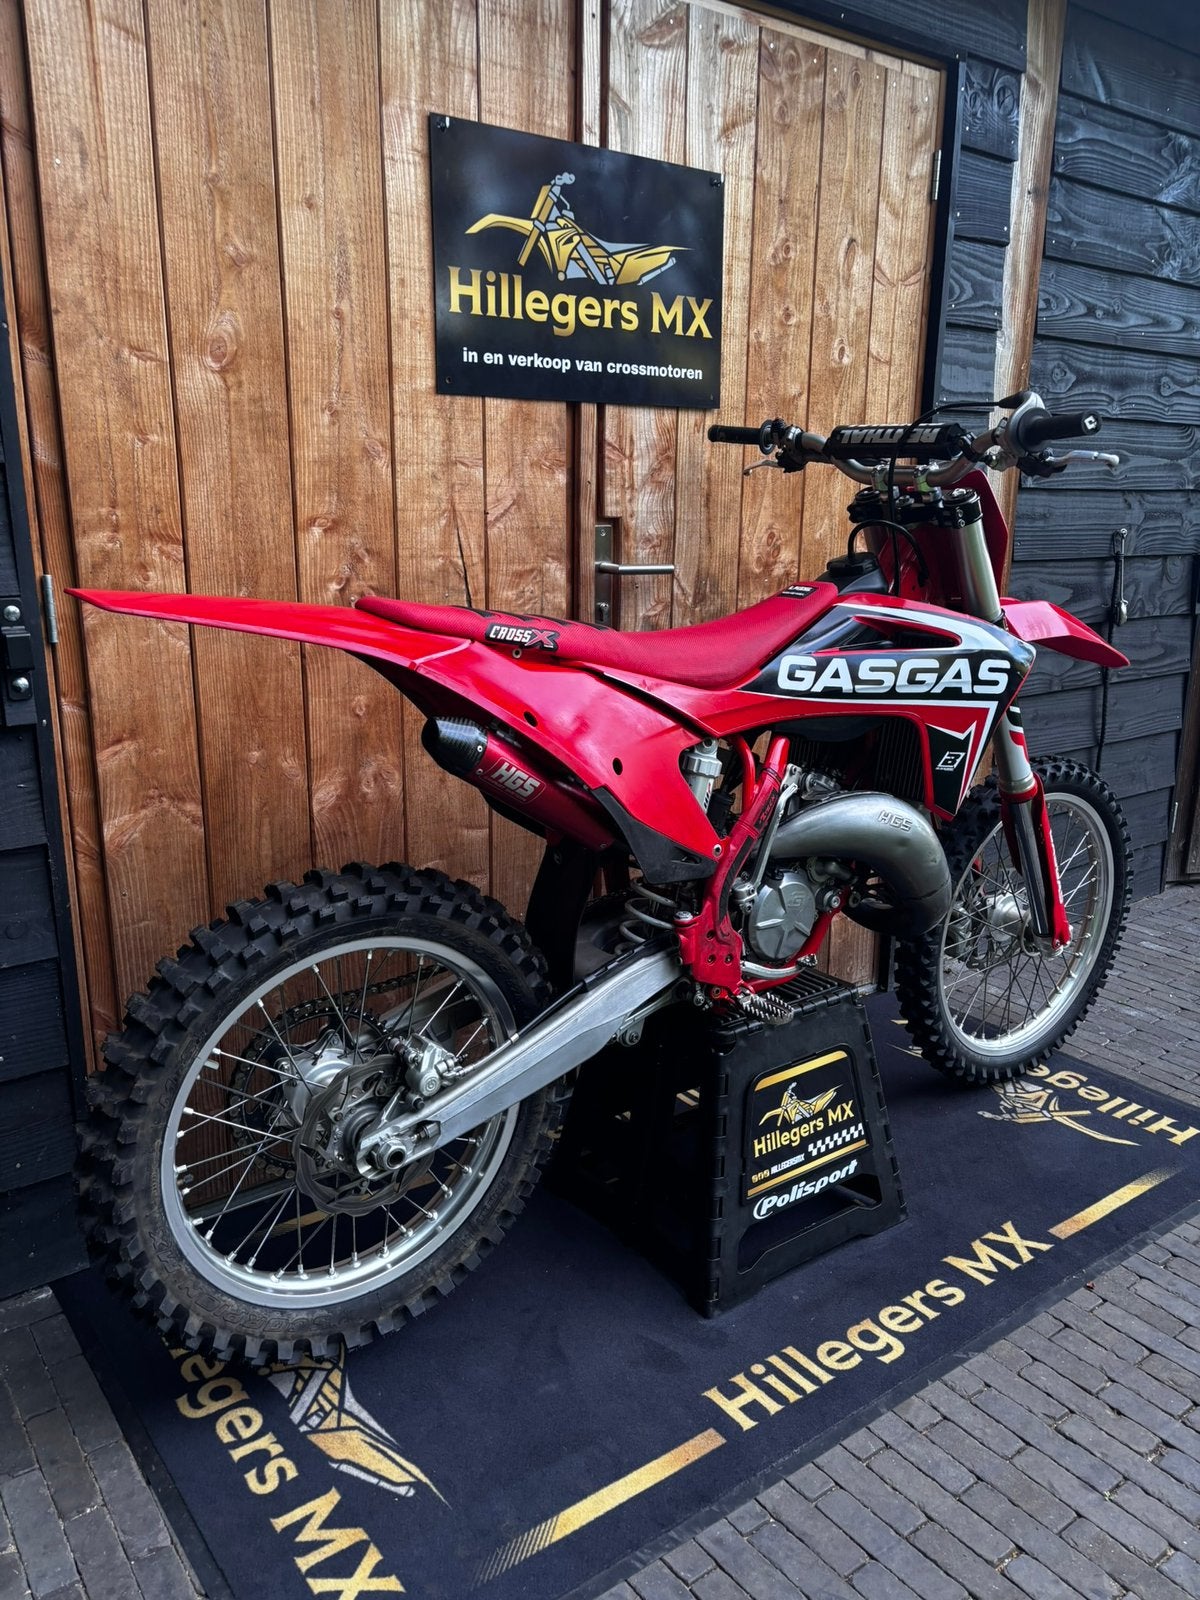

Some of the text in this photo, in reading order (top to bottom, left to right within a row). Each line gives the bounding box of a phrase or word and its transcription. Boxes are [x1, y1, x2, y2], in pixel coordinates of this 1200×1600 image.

[447, 265, 714, 339] Hillegers MX
[463, 347, 703, 380] in en verkoop van crossmotoren
[777, 655, 1011, 694] GASGAS
[491, 761, 541, 798] HGS
[877, 809, 913, 833] HGS
[753, 1099, 855, 1158] Hillegers MX
[1025, 1063, 1200, 1146] Hillege
[753, 1159, 858, 1220] Polisport
[701, 1220, 1055, 1432] Hillegers MX
[168, 1347, 407, 1600] egers MX
